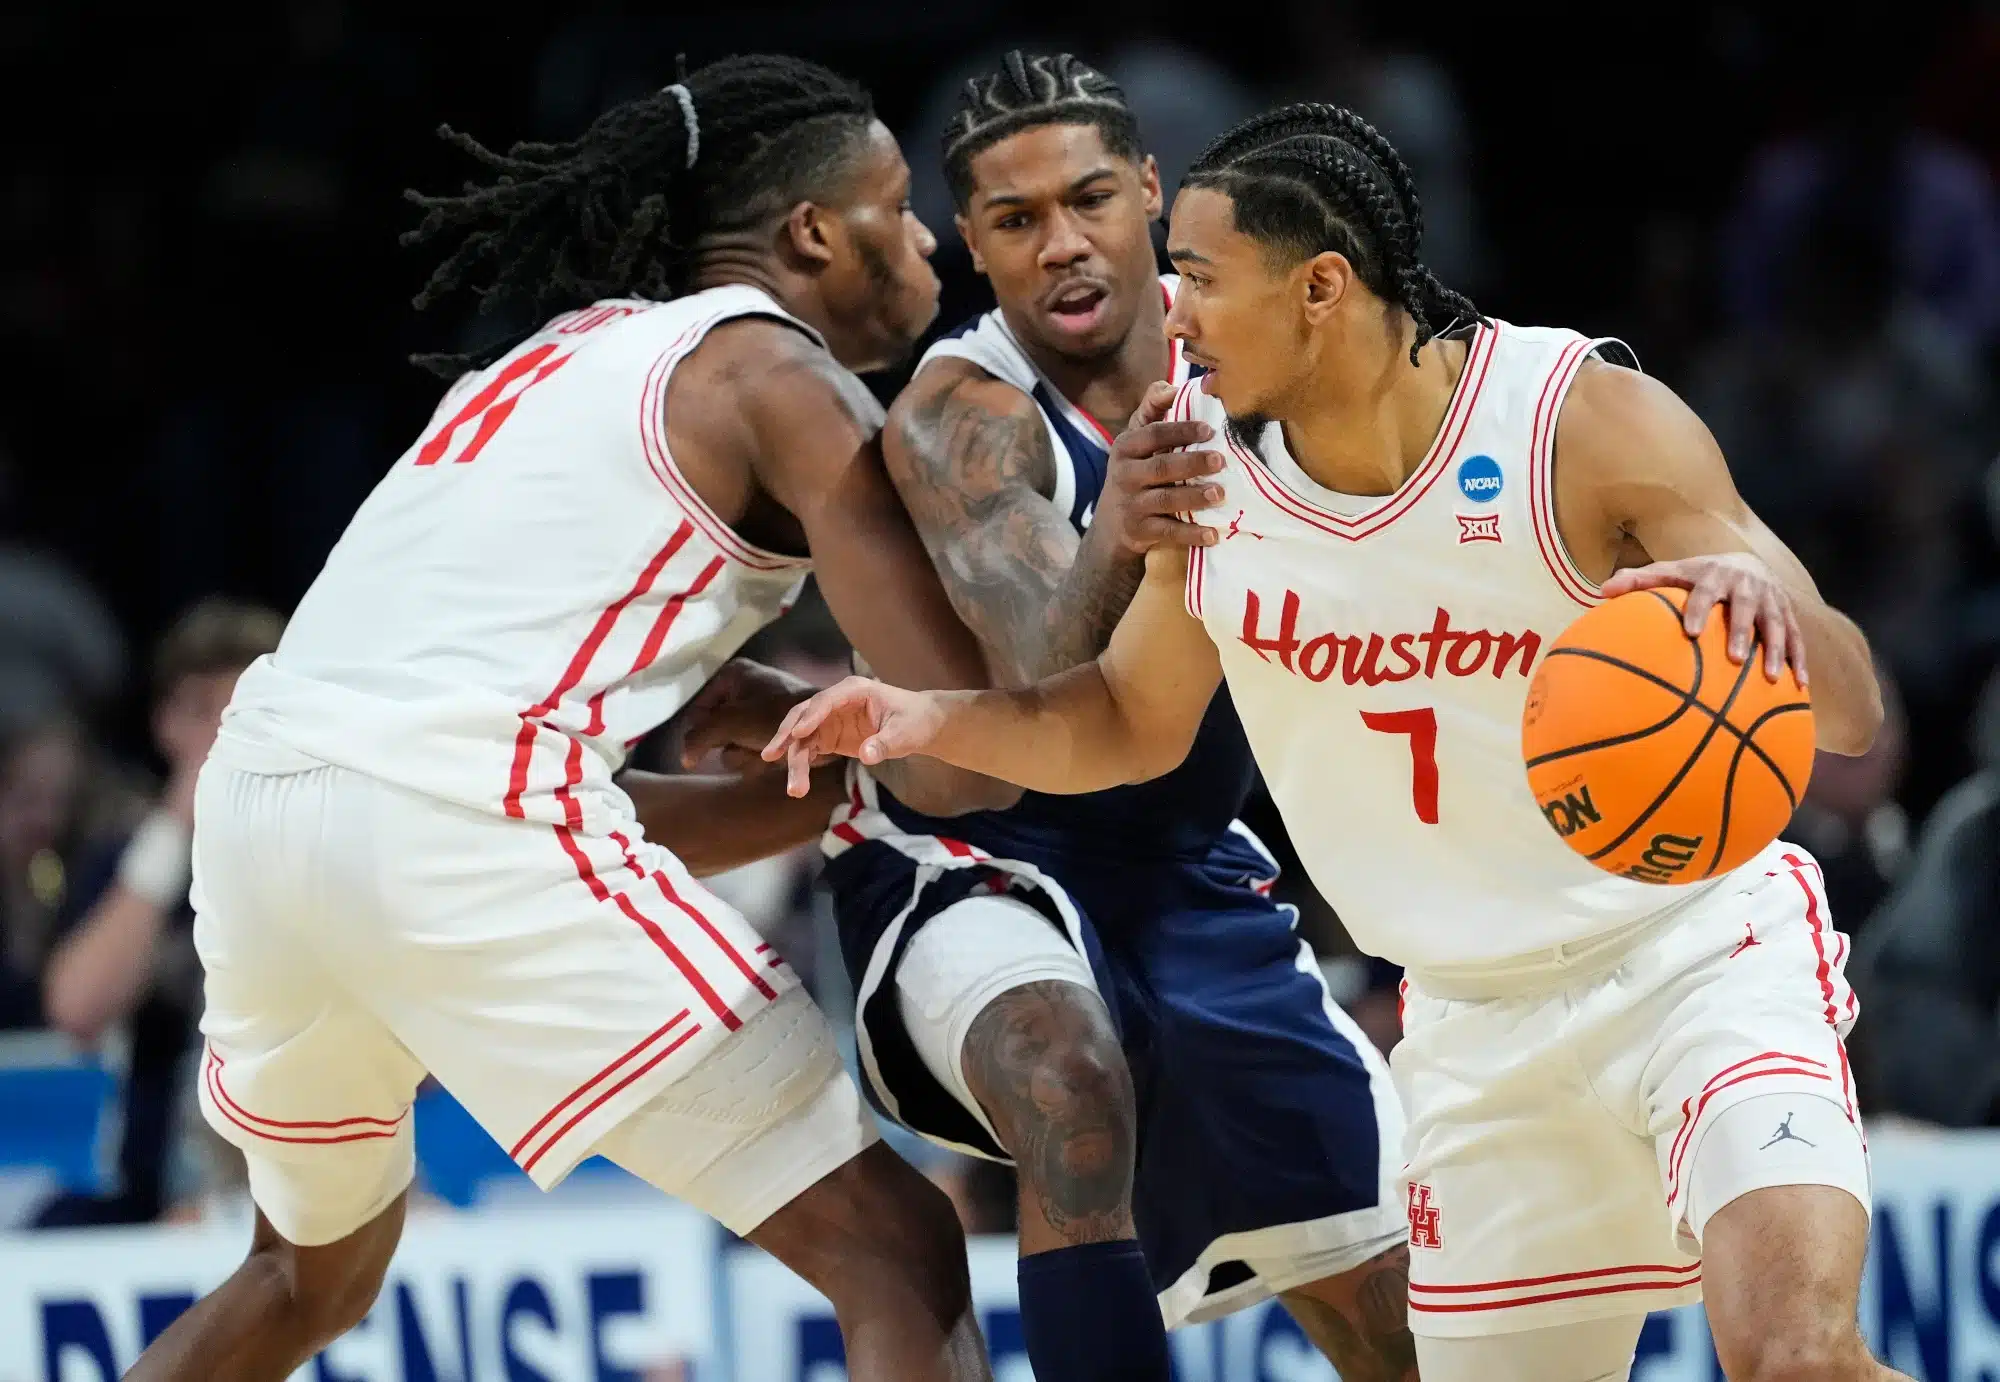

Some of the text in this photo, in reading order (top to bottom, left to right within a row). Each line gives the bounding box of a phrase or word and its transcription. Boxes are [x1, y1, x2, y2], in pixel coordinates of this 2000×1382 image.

[1464, 476, 1500, 491] NCAA
[1236, 588, 1542, 687] Houston
[1359, 706, 1439, 824] 7
